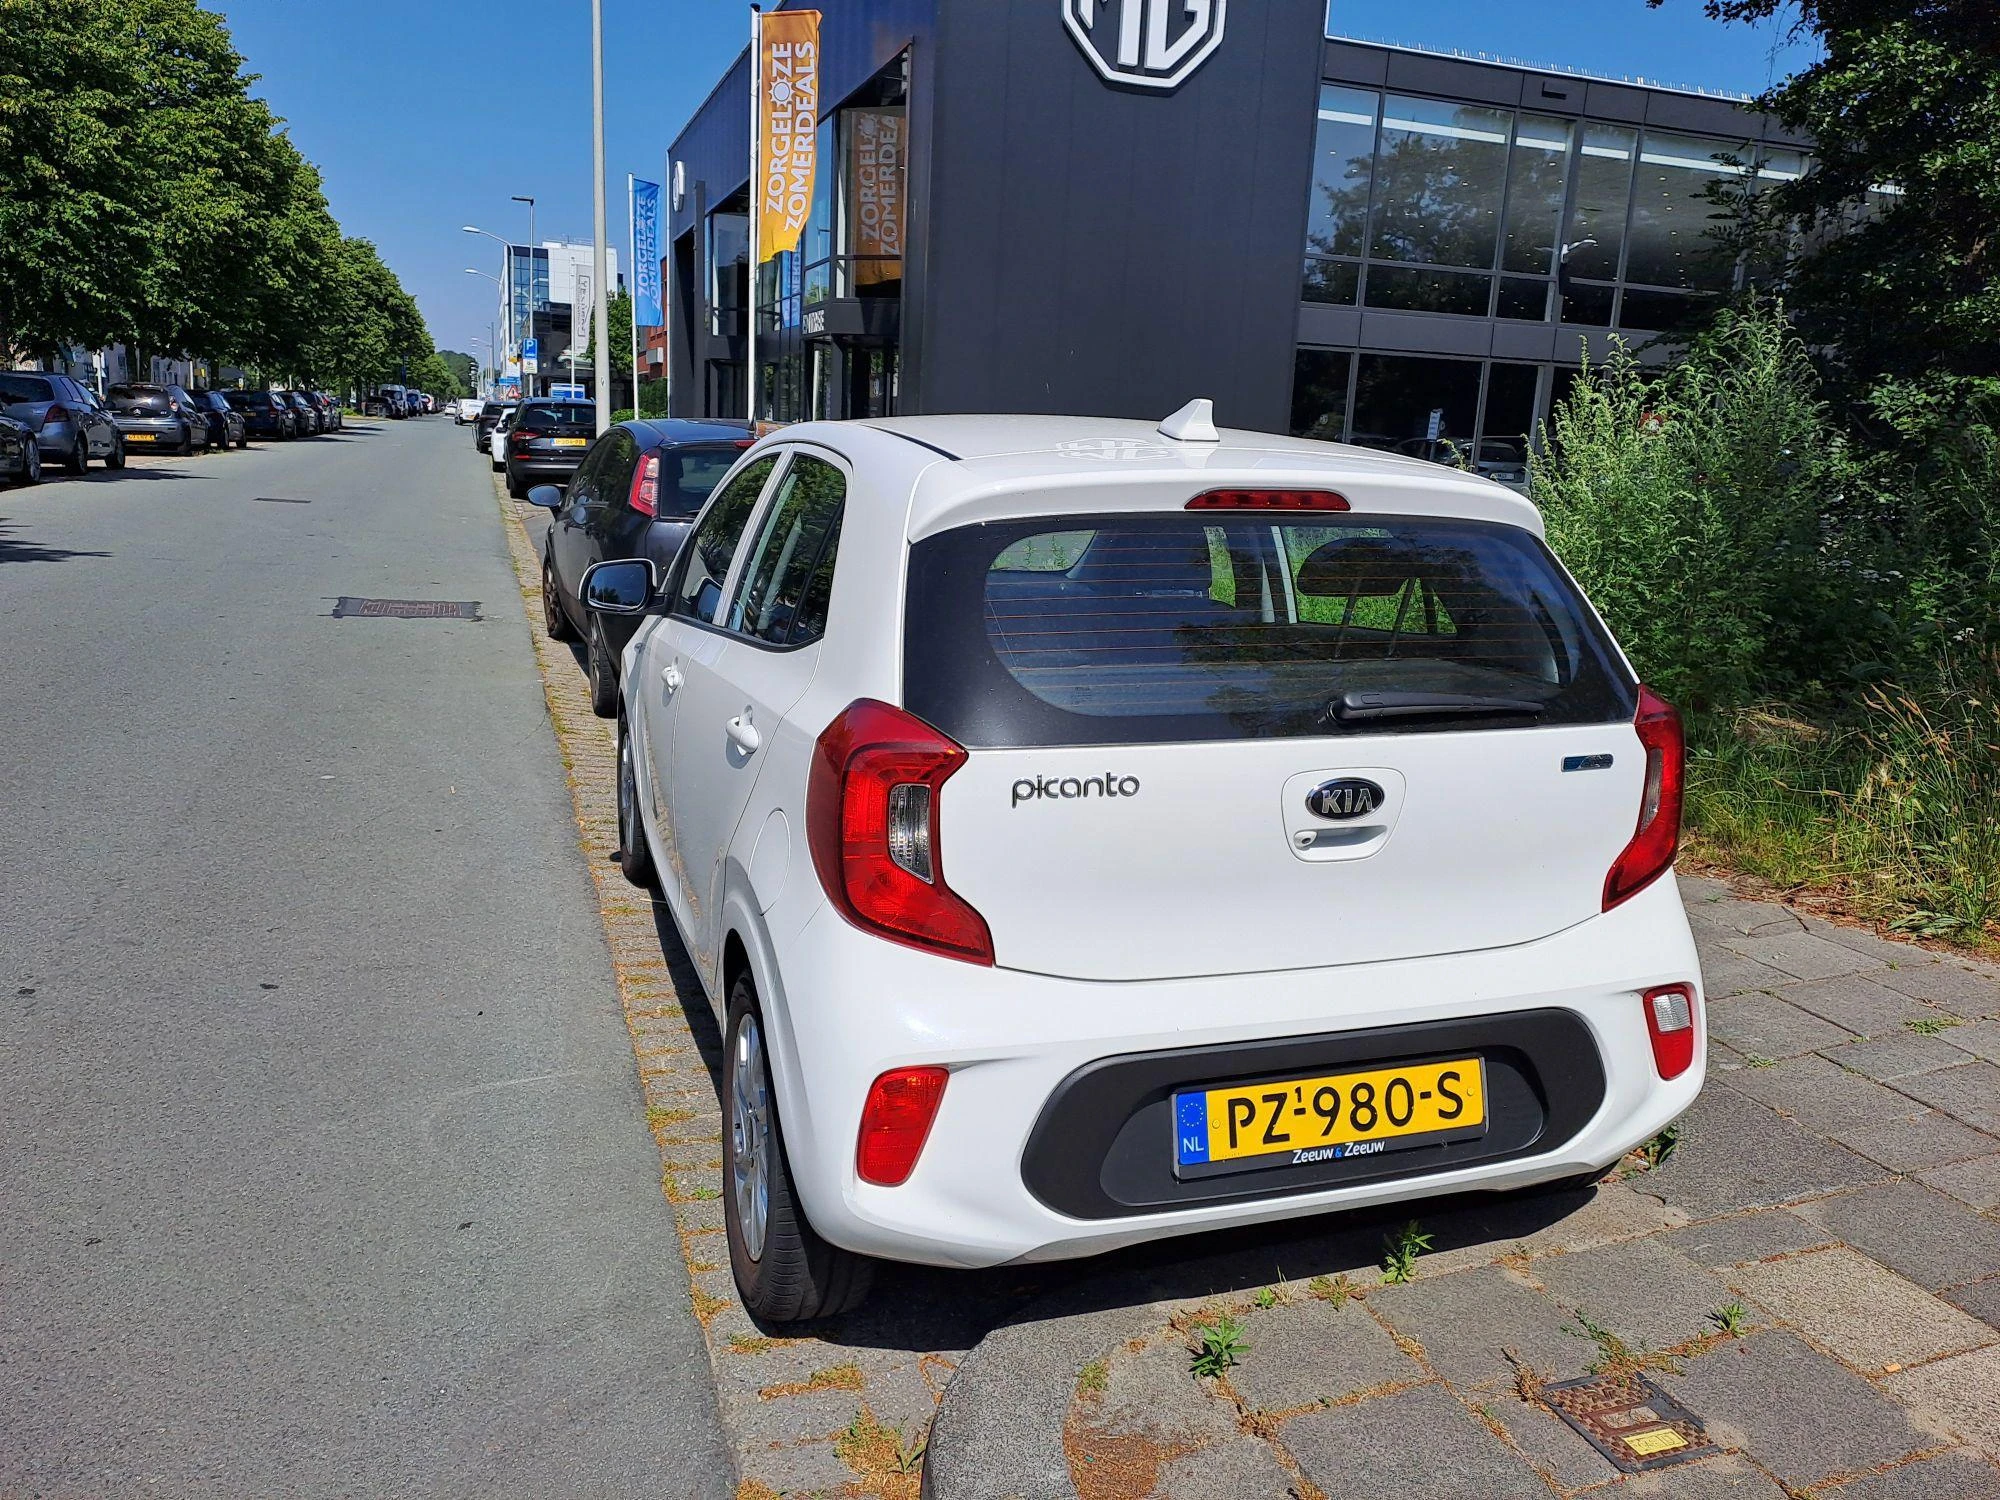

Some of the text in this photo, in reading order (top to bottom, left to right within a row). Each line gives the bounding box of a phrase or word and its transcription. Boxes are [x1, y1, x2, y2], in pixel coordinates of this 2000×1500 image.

[1078, 0, 1211, 70] MG
[766, 42, 794, 214] ZORGELOZE
[784, 40, 815, 232] ZOMERDEALS
[646, 198, 661, 310] ZOMERDEALS
[526, 340, 534, 350] P
[1012, 771, 1140, 809] picanto
[1321, 789, 1375, 814] KIA
[1183, 1137, 1205, 1153] NL
[1293, 1139, 1385, 1164] Zeeuw & Zeeuw
